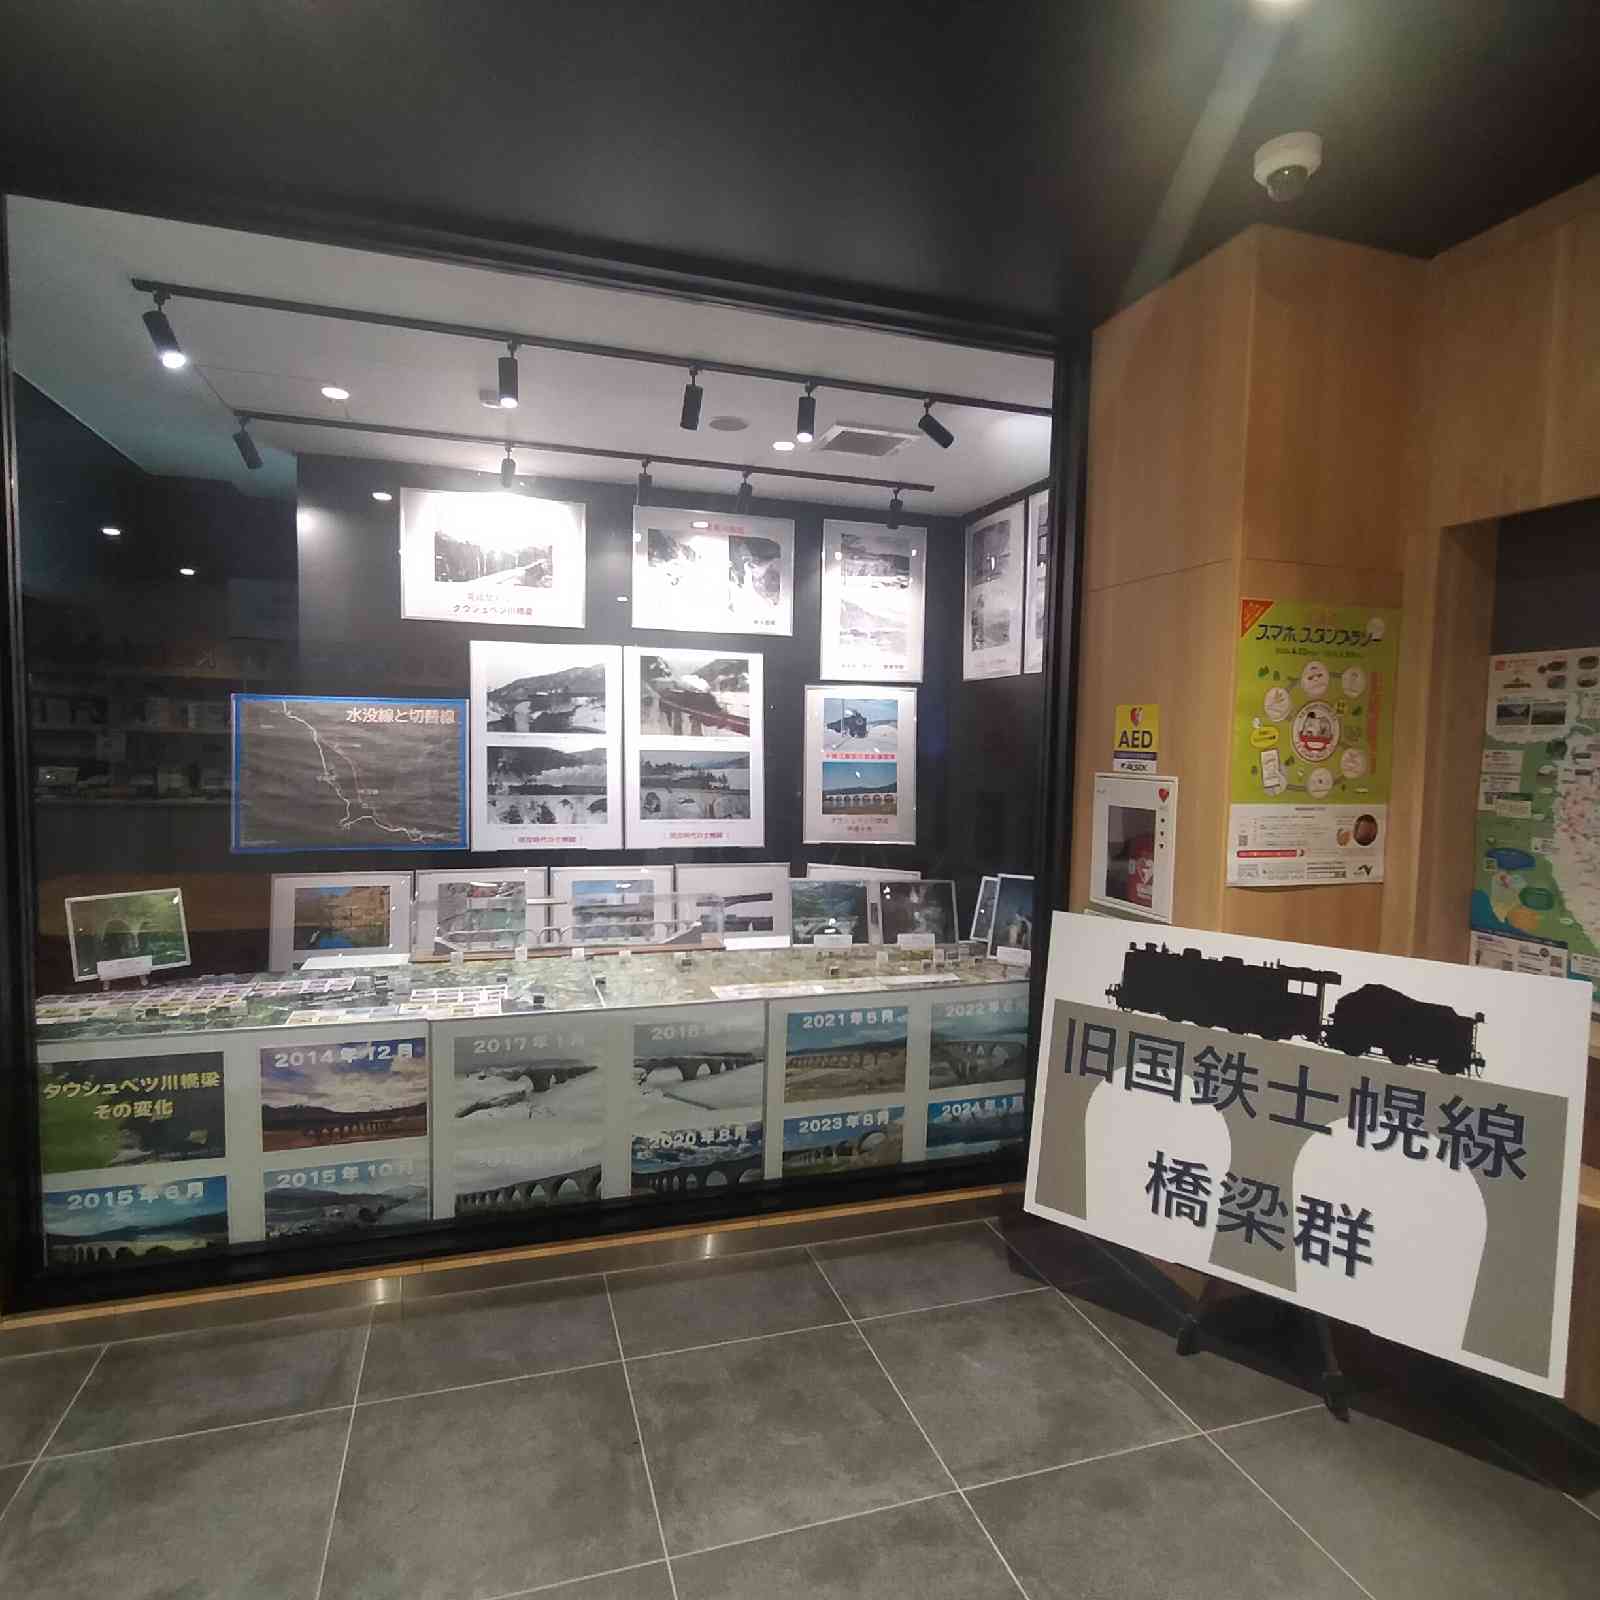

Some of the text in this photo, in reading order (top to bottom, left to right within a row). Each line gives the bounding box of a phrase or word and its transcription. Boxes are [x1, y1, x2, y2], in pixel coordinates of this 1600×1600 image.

[1119, 730, 1153, 749] AED
[802, 1009, 894, 1029] 2021年5月
[274, 1043, 413, 1068] 2014年12月
[43, 1071, 221, 1099] タウシュベツ川橋梁
[94, 1099, 175, 1120] その変化
[1064, 1017, 1528, 1181] 旧国鉄士幌線
[1144, 1149, 1375, 1278] 橋梁群
